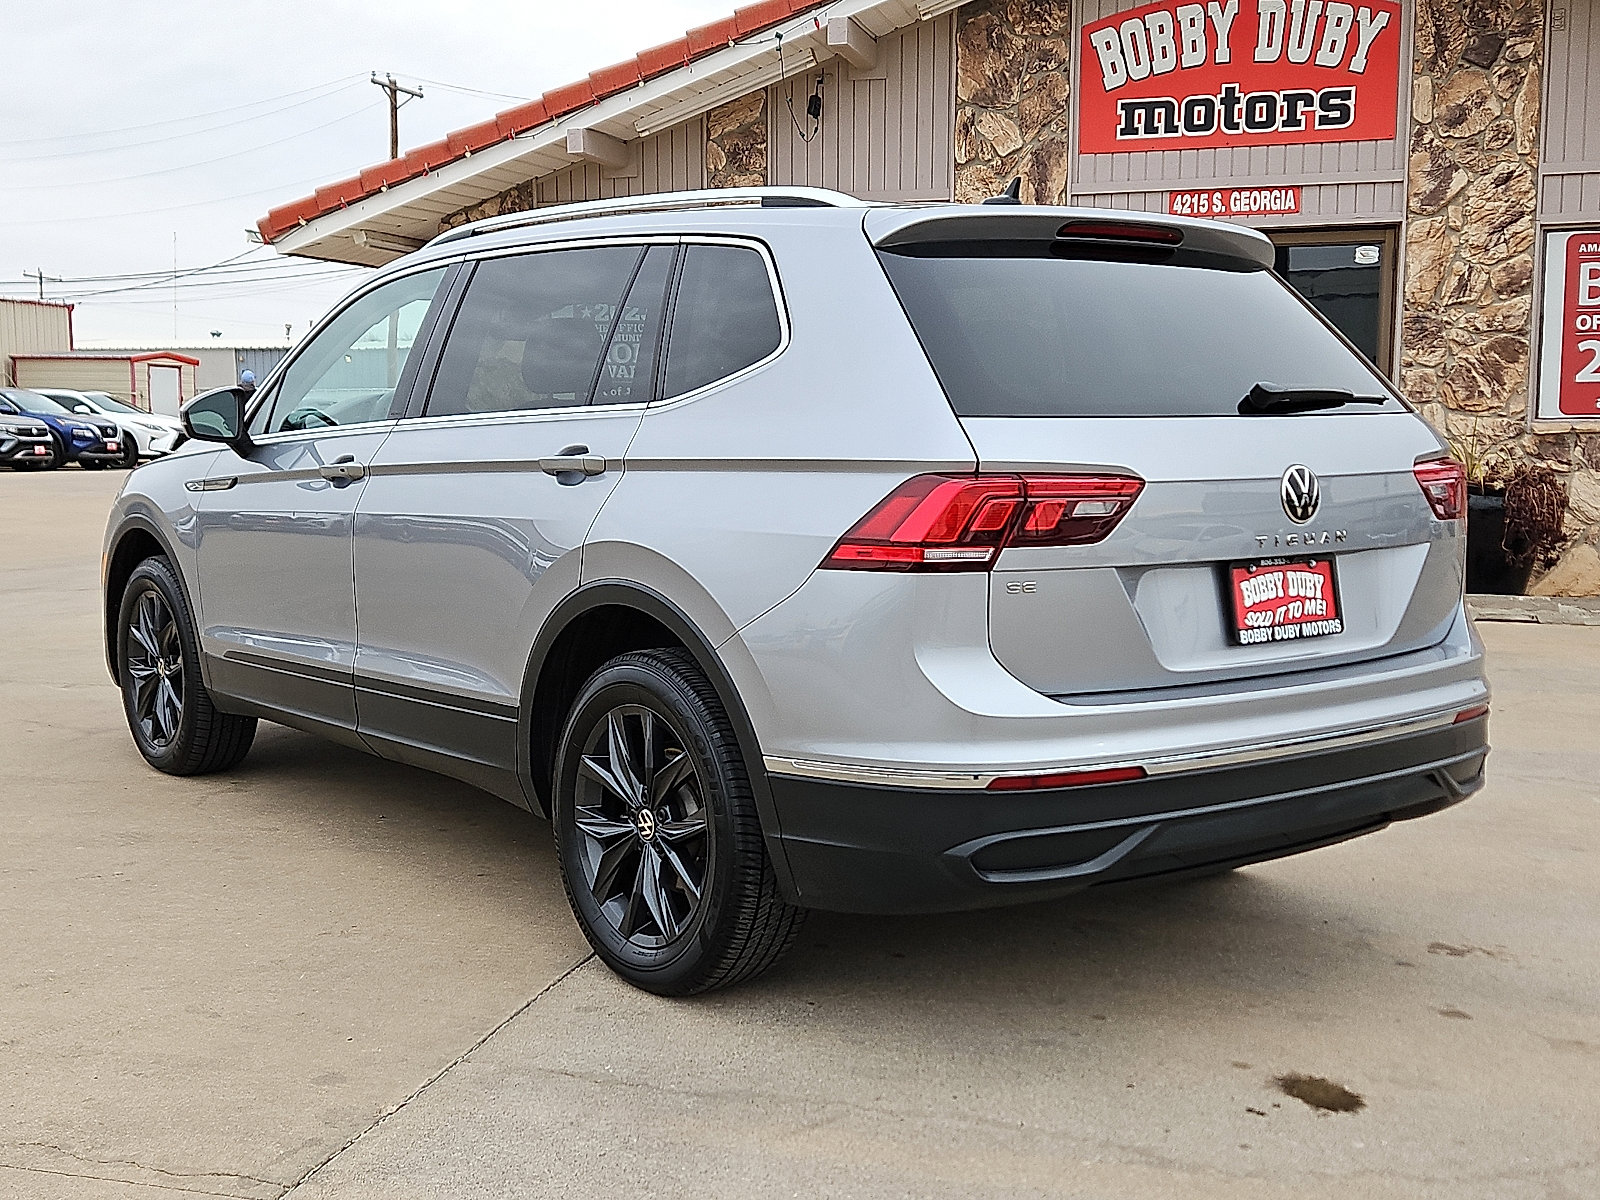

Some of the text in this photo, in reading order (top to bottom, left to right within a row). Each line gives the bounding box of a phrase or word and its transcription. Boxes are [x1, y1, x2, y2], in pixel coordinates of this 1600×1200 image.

[1090, 0, 1390, 91] BOBBY DUBY
[1117, 84, 1356, 140] motors
[1172, 189, 1296, 214] 4215 S. GEORGIA
[1578, 243, 1600, 253] AM
[1254, 528, 1347, 549] TIGUAN
[1006, 580, 1037, 595] SE
[1240, 570, 1324, 609] BOBBY DUBY
[1244, 610, 1273, 628] SOLD
[1275, 605, 1287, 625] IT
[1287, 600, 1303, 620] TO
[1240, 618, 1342, 645] BOBBY DUBY MOTORS
